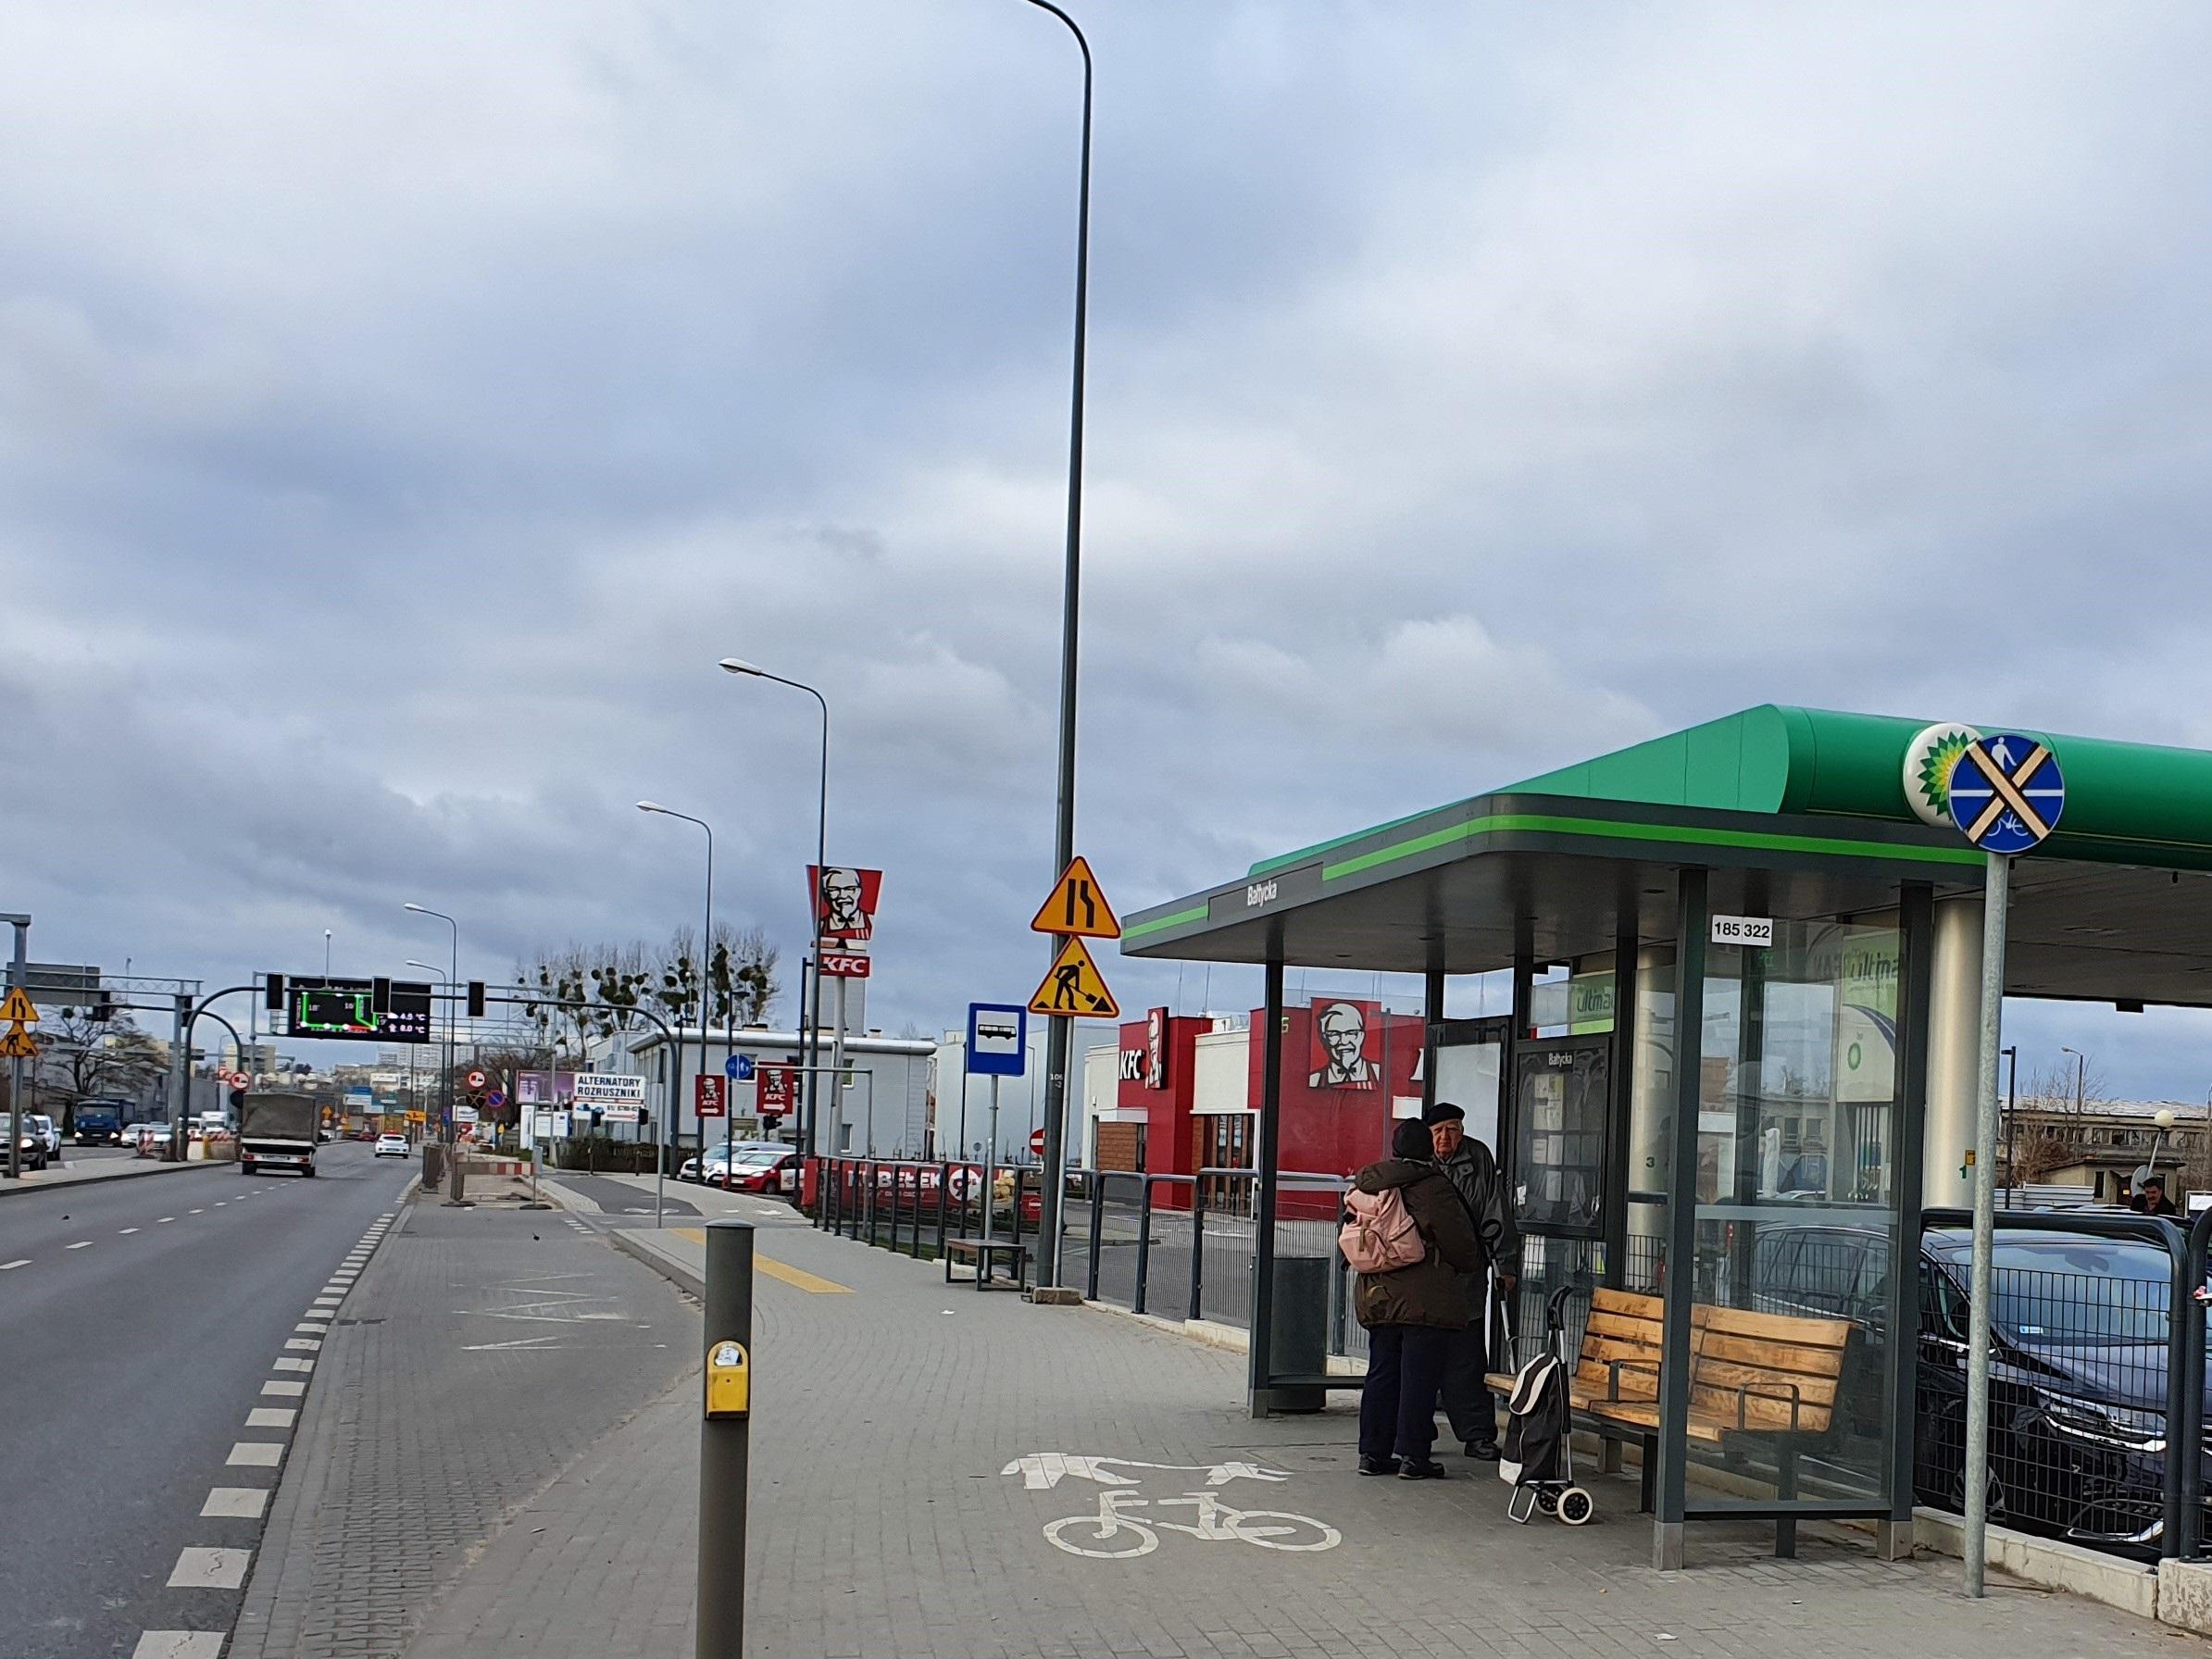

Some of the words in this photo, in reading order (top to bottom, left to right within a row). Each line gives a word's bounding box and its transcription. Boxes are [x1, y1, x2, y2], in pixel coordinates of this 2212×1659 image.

[1715, 921, 1740, 936] 185
[1743, 924, 1770, 938] 322
[823, 956, 868, 973] KFC
[1118, 1049, 1143, 1080] KFC
[578, 1076, 642, 1088] ALTERNATORY
[577, 1086, 641, 1098] ROZRUSZNIKI
[1645, 1156, 1656, 1168] 3
[1959, 1165, 1967, 1179] 1
